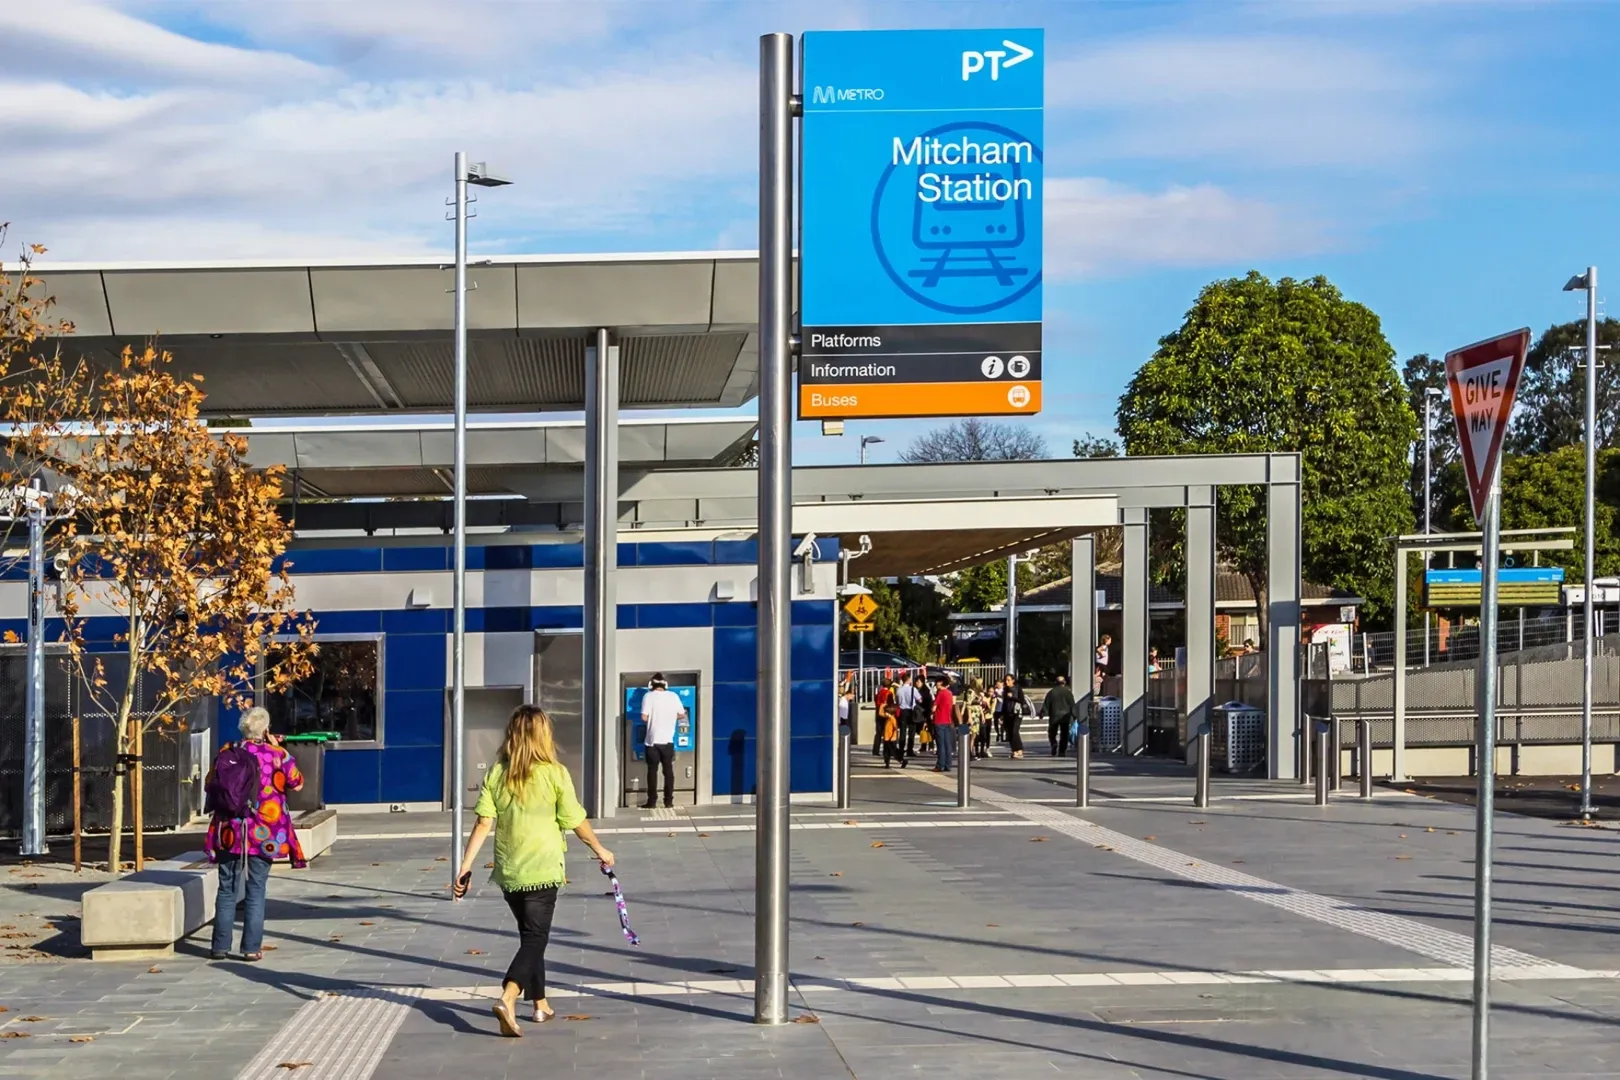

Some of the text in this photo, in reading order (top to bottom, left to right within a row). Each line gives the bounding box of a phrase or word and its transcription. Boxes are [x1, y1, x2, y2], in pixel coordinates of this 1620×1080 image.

[837, 88, 885, 101] METRO
[892, 136, 1033, 166] Mitcham
[918, 172, 1032, 203] Station
[811, 333, 882, 348] Platforms
[811, 363, 896, 378] Information
[1466, 369, 1502, 406] GIVE
[811, 393, 858, 407] Buses
[1471, 407, 1494, 434] WAY
